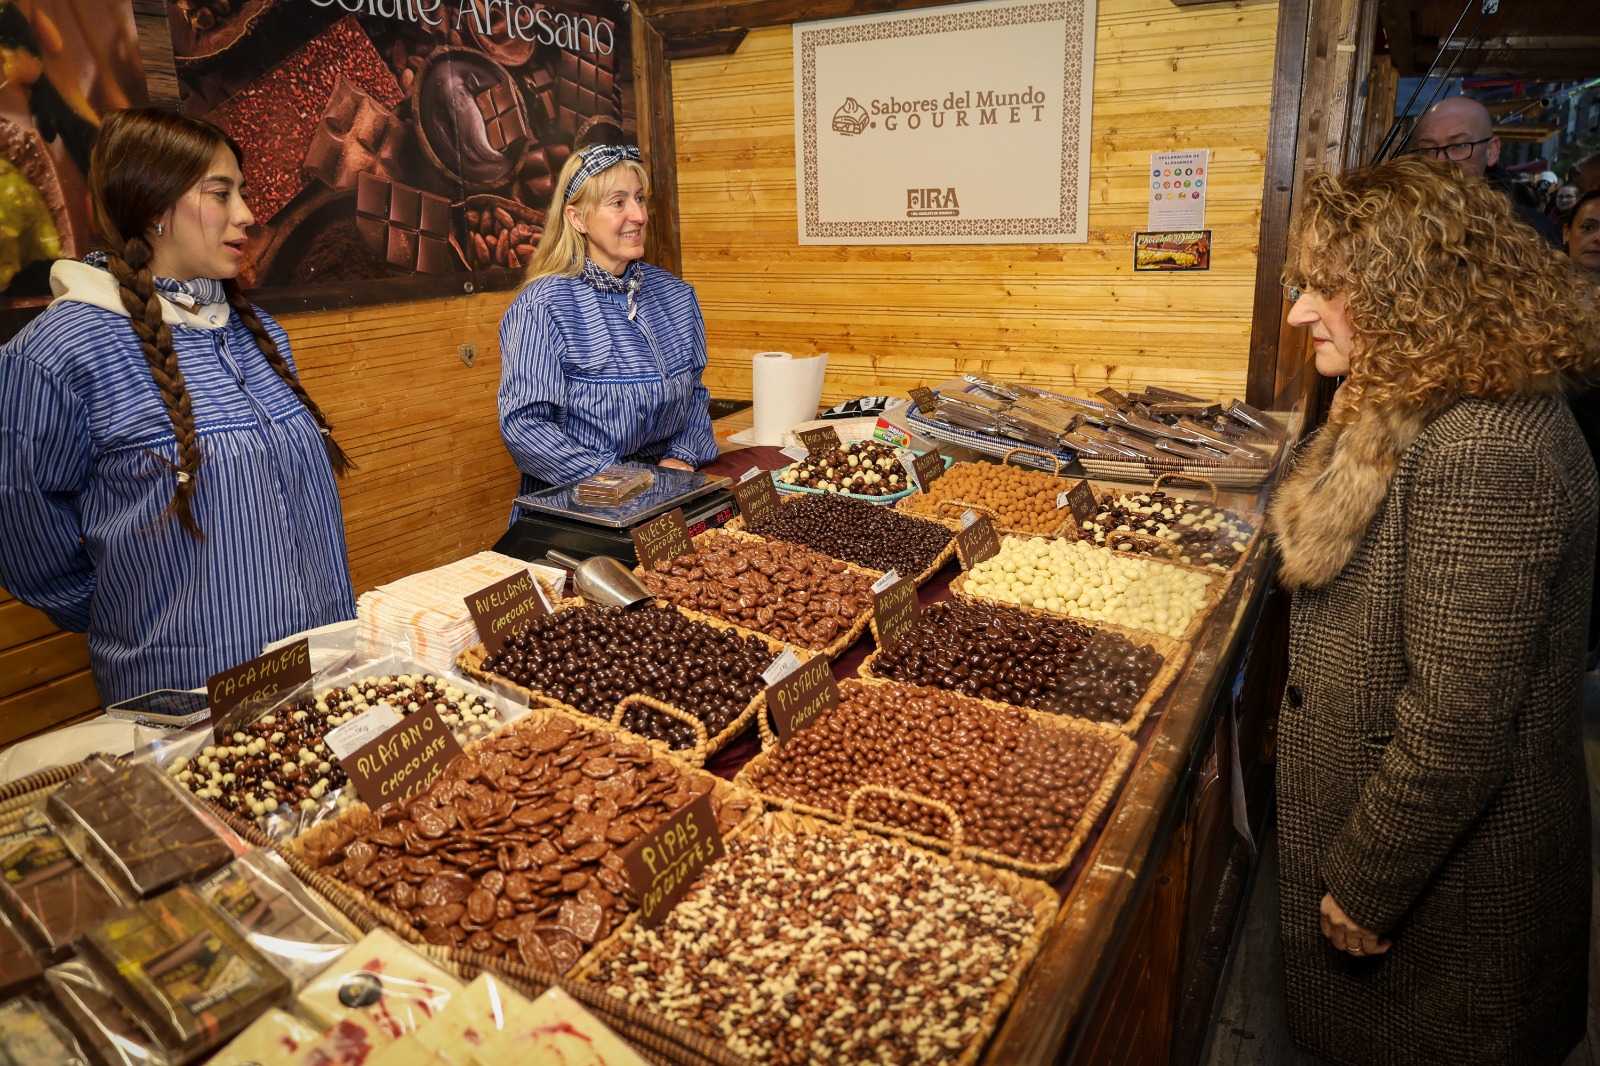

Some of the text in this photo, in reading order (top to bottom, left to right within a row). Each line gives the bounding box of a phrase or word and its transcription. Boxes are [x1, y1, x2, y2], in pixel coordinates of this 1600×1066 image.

[456, 0, 614, 55] Artesano
[871, 86, 1046, 115] Sabores del Mundo
[885, 105, 1045, 131] GOURMET
[907, 188, 959, 209] FIRA
[1137, 234, 1174, 247] Chocolate
[638, 514, 675, 545] NUECES
[647, 526, 683, 558] CHOCOLATE
[667, 540, 688, 560] LECHE
[475, 574, 533, 615] AVELLANAS
[214, 644, 308, 703] CACAHUETE
[777, 661, 829, 712] PISTACHO
[357, 717, 433, 780] PLATANO
[381, 735, 446, 796] CHOCOLATE
[642, 812, 698, 875] PIPAS
